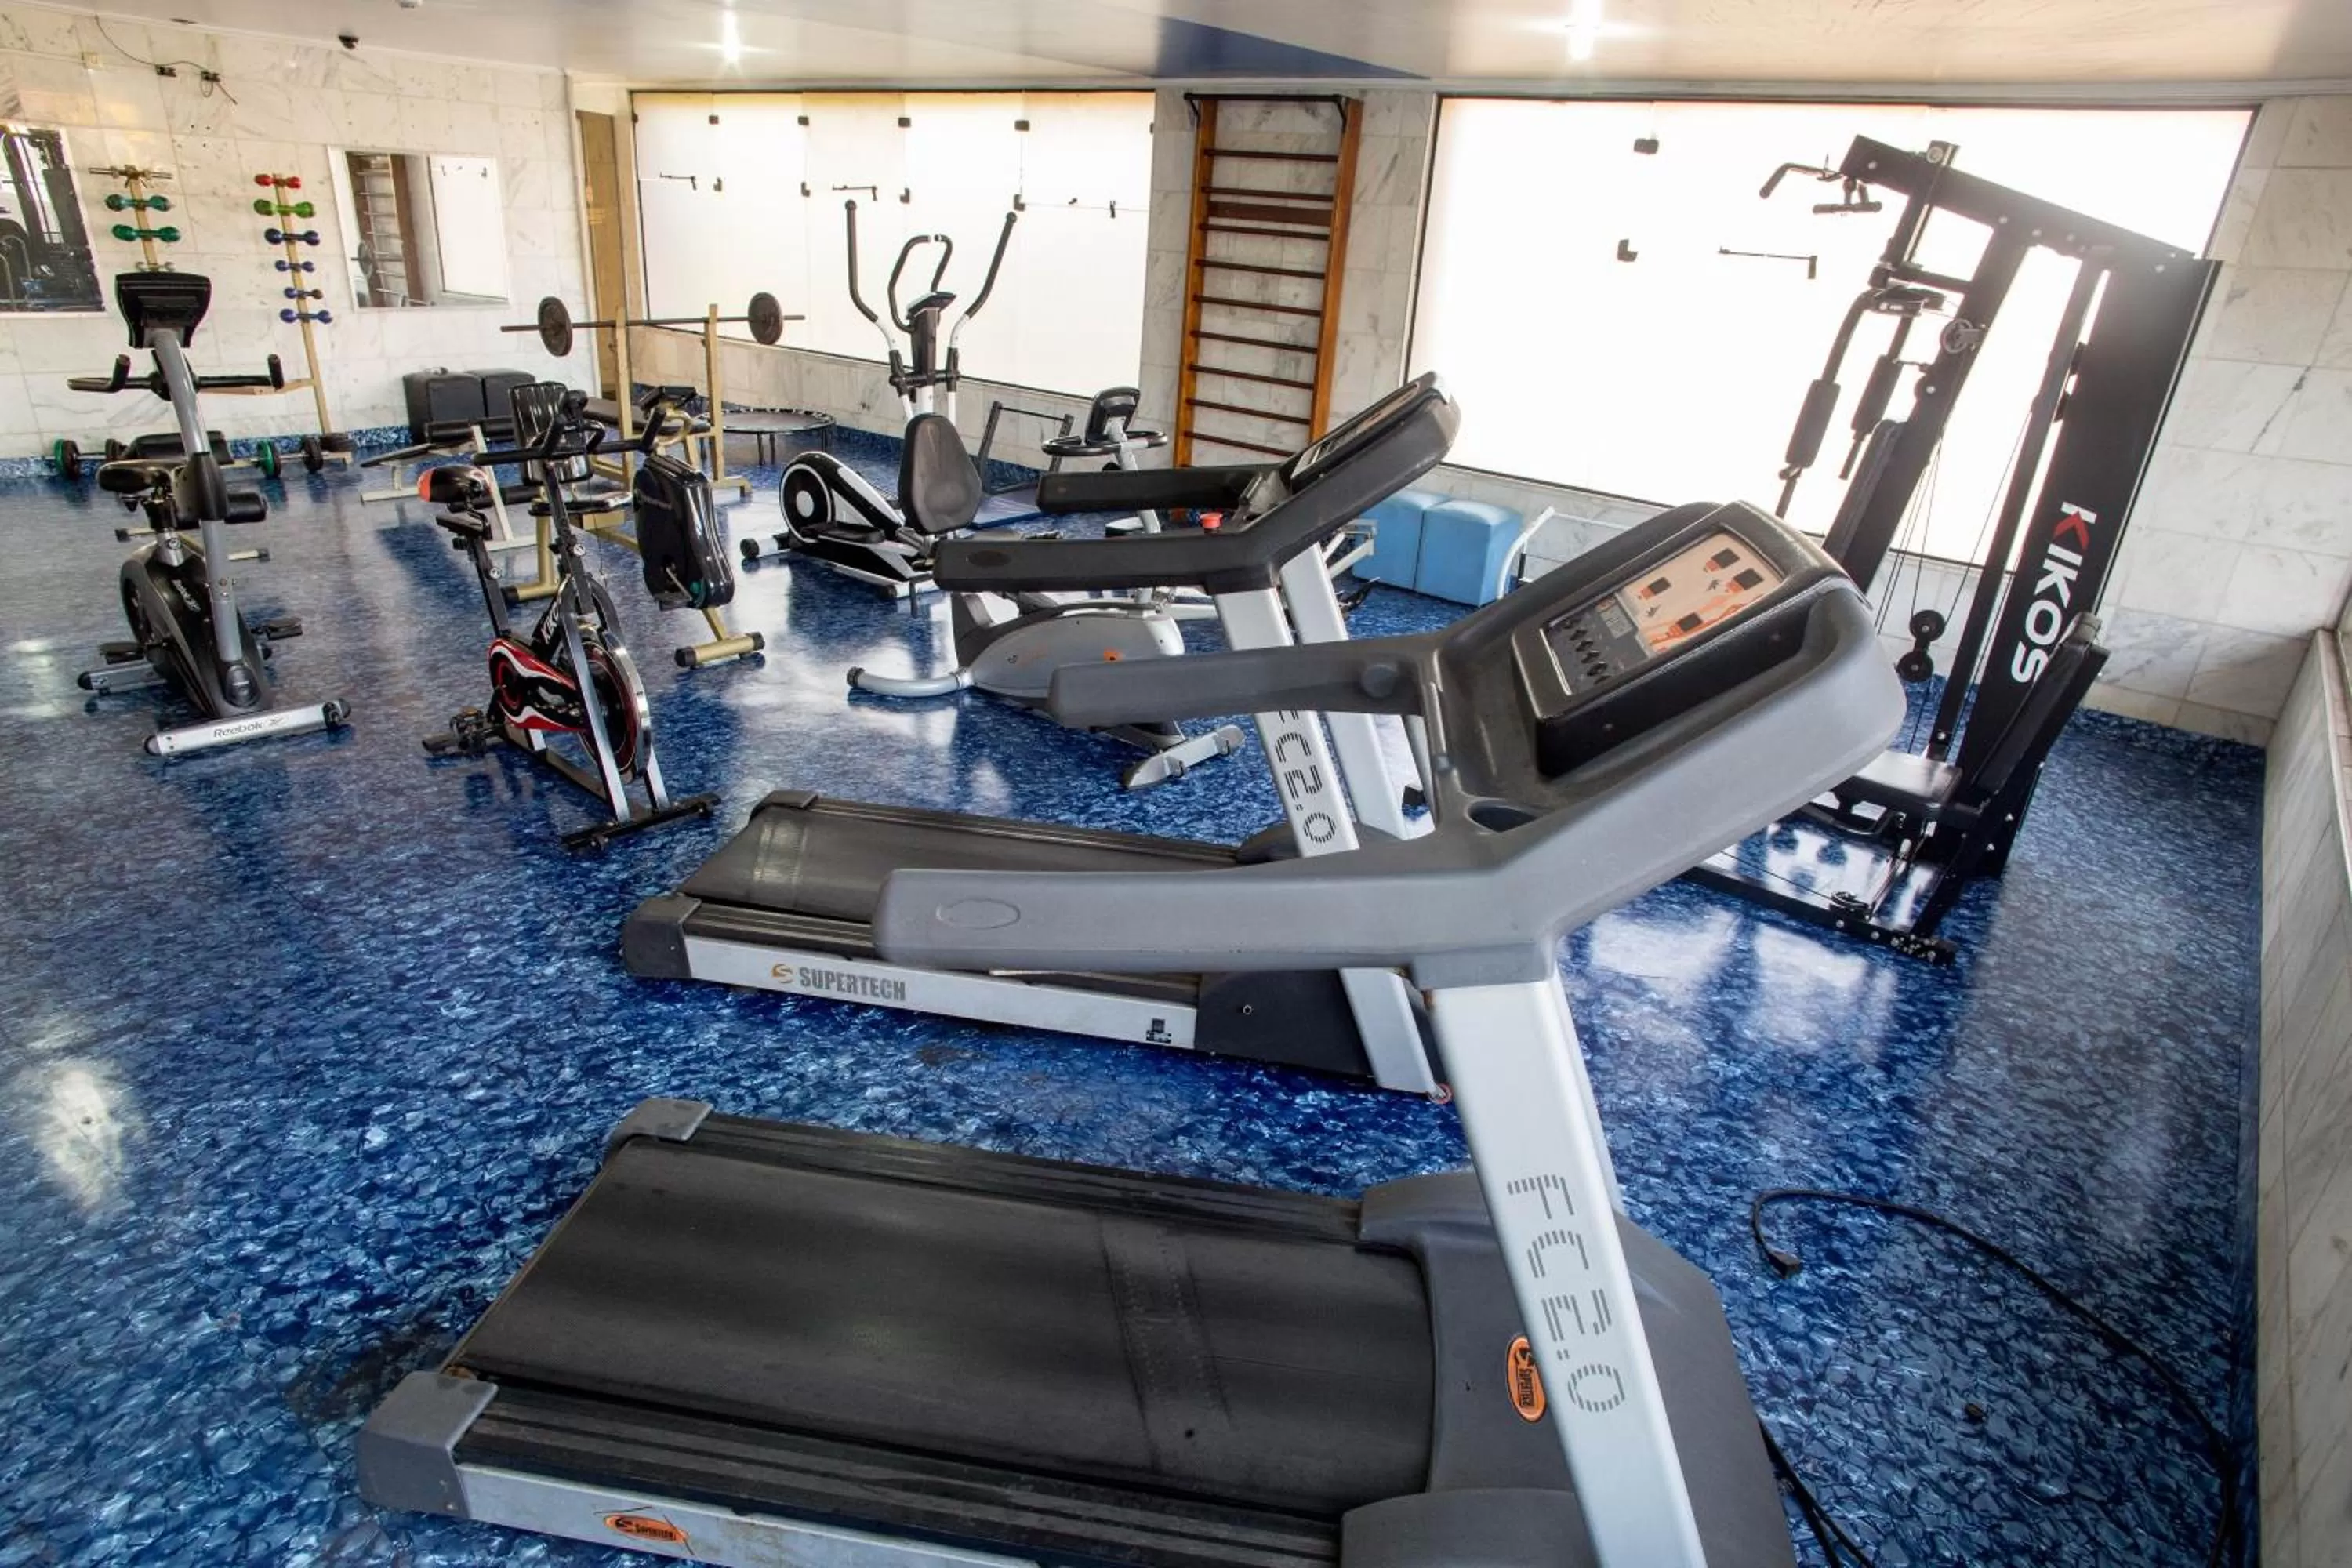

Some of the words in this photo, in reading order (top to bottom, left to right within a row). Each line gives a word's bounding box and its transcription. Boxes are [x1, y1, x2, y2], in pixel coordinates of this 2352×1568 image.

[2010, 501, 2098, 683] KIKOS
[212, 720, 264, 739] Reebok
[798, 967, 906, 1001] SUPERTECH
